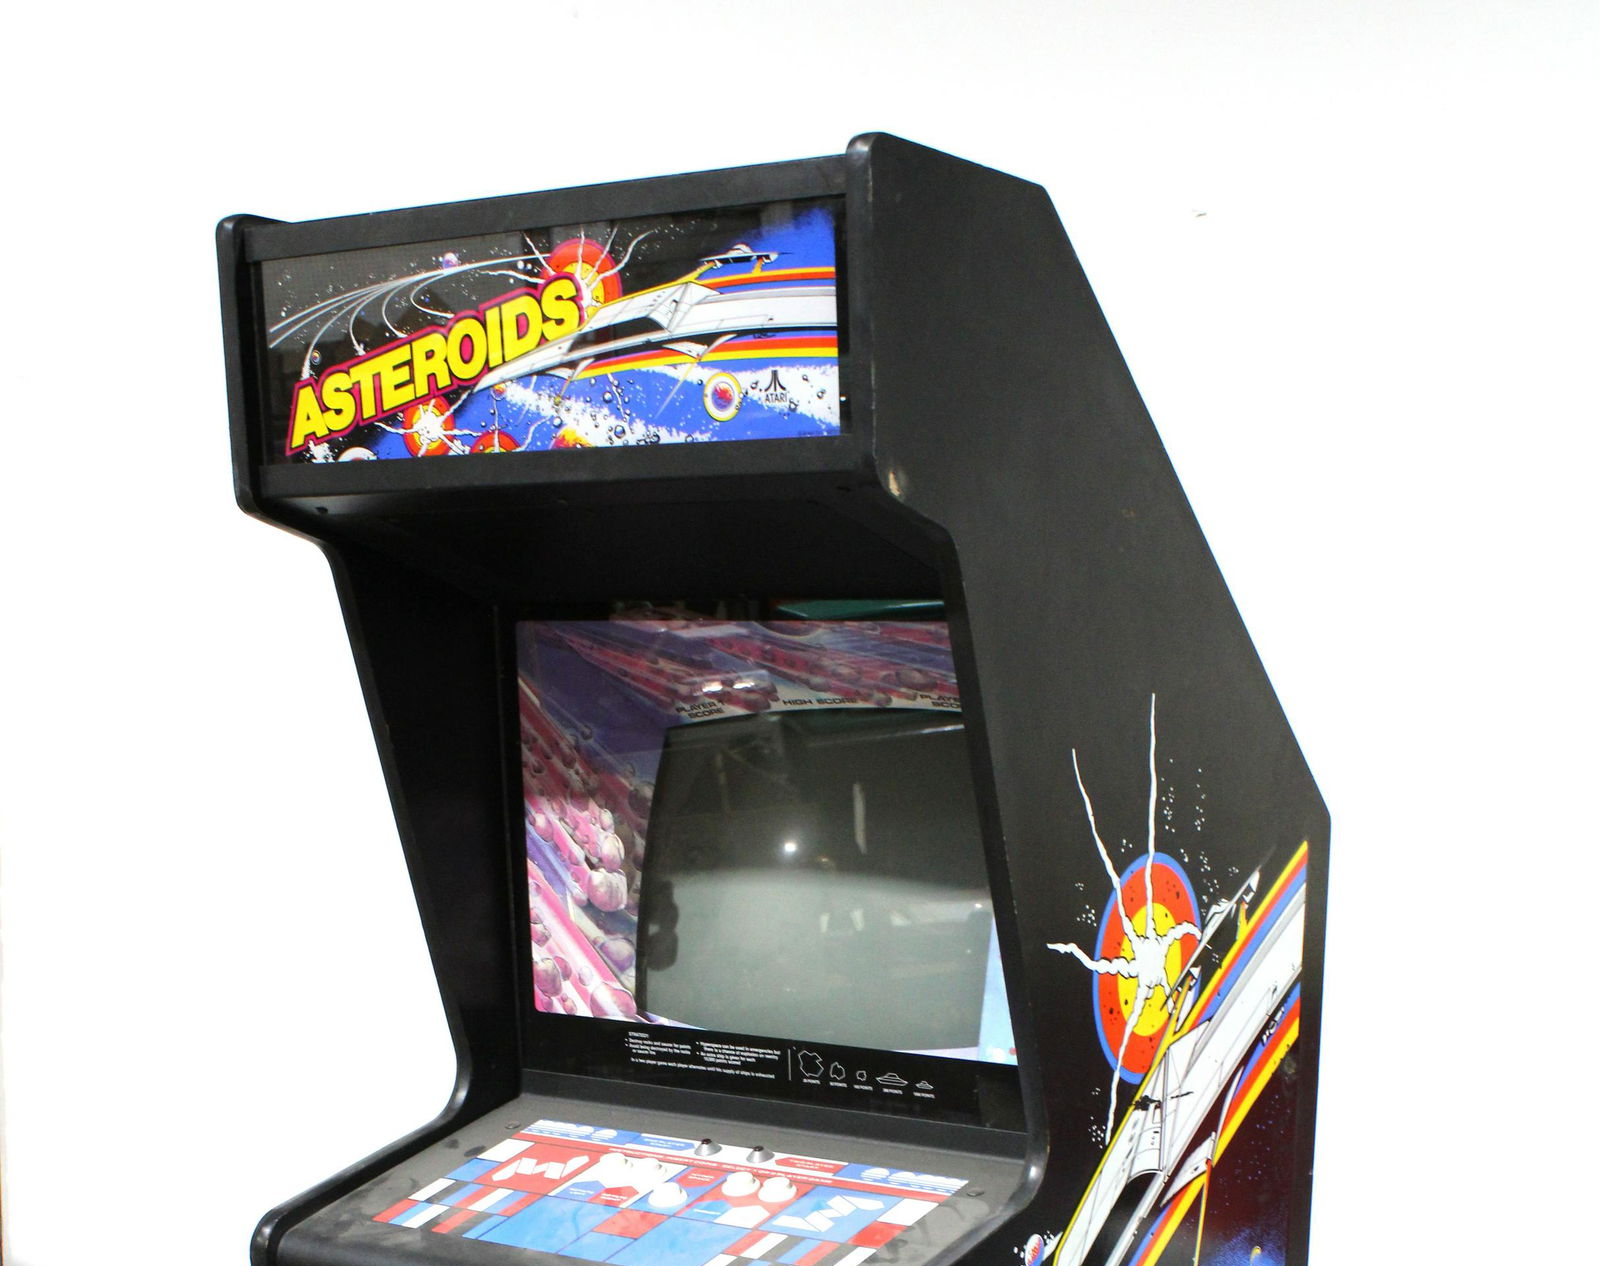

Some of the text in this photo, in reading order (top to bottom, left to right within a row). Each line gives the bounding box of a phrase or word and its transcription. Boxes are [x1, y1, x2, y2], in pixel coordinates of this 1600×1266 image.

[287, 276, 584, 451] ASTEROIDS
[765, 392, 788, 403] ATARI
[783, 697, 858, 706] HIGH SCORE
[688, 707, 725, 718] SCORE
